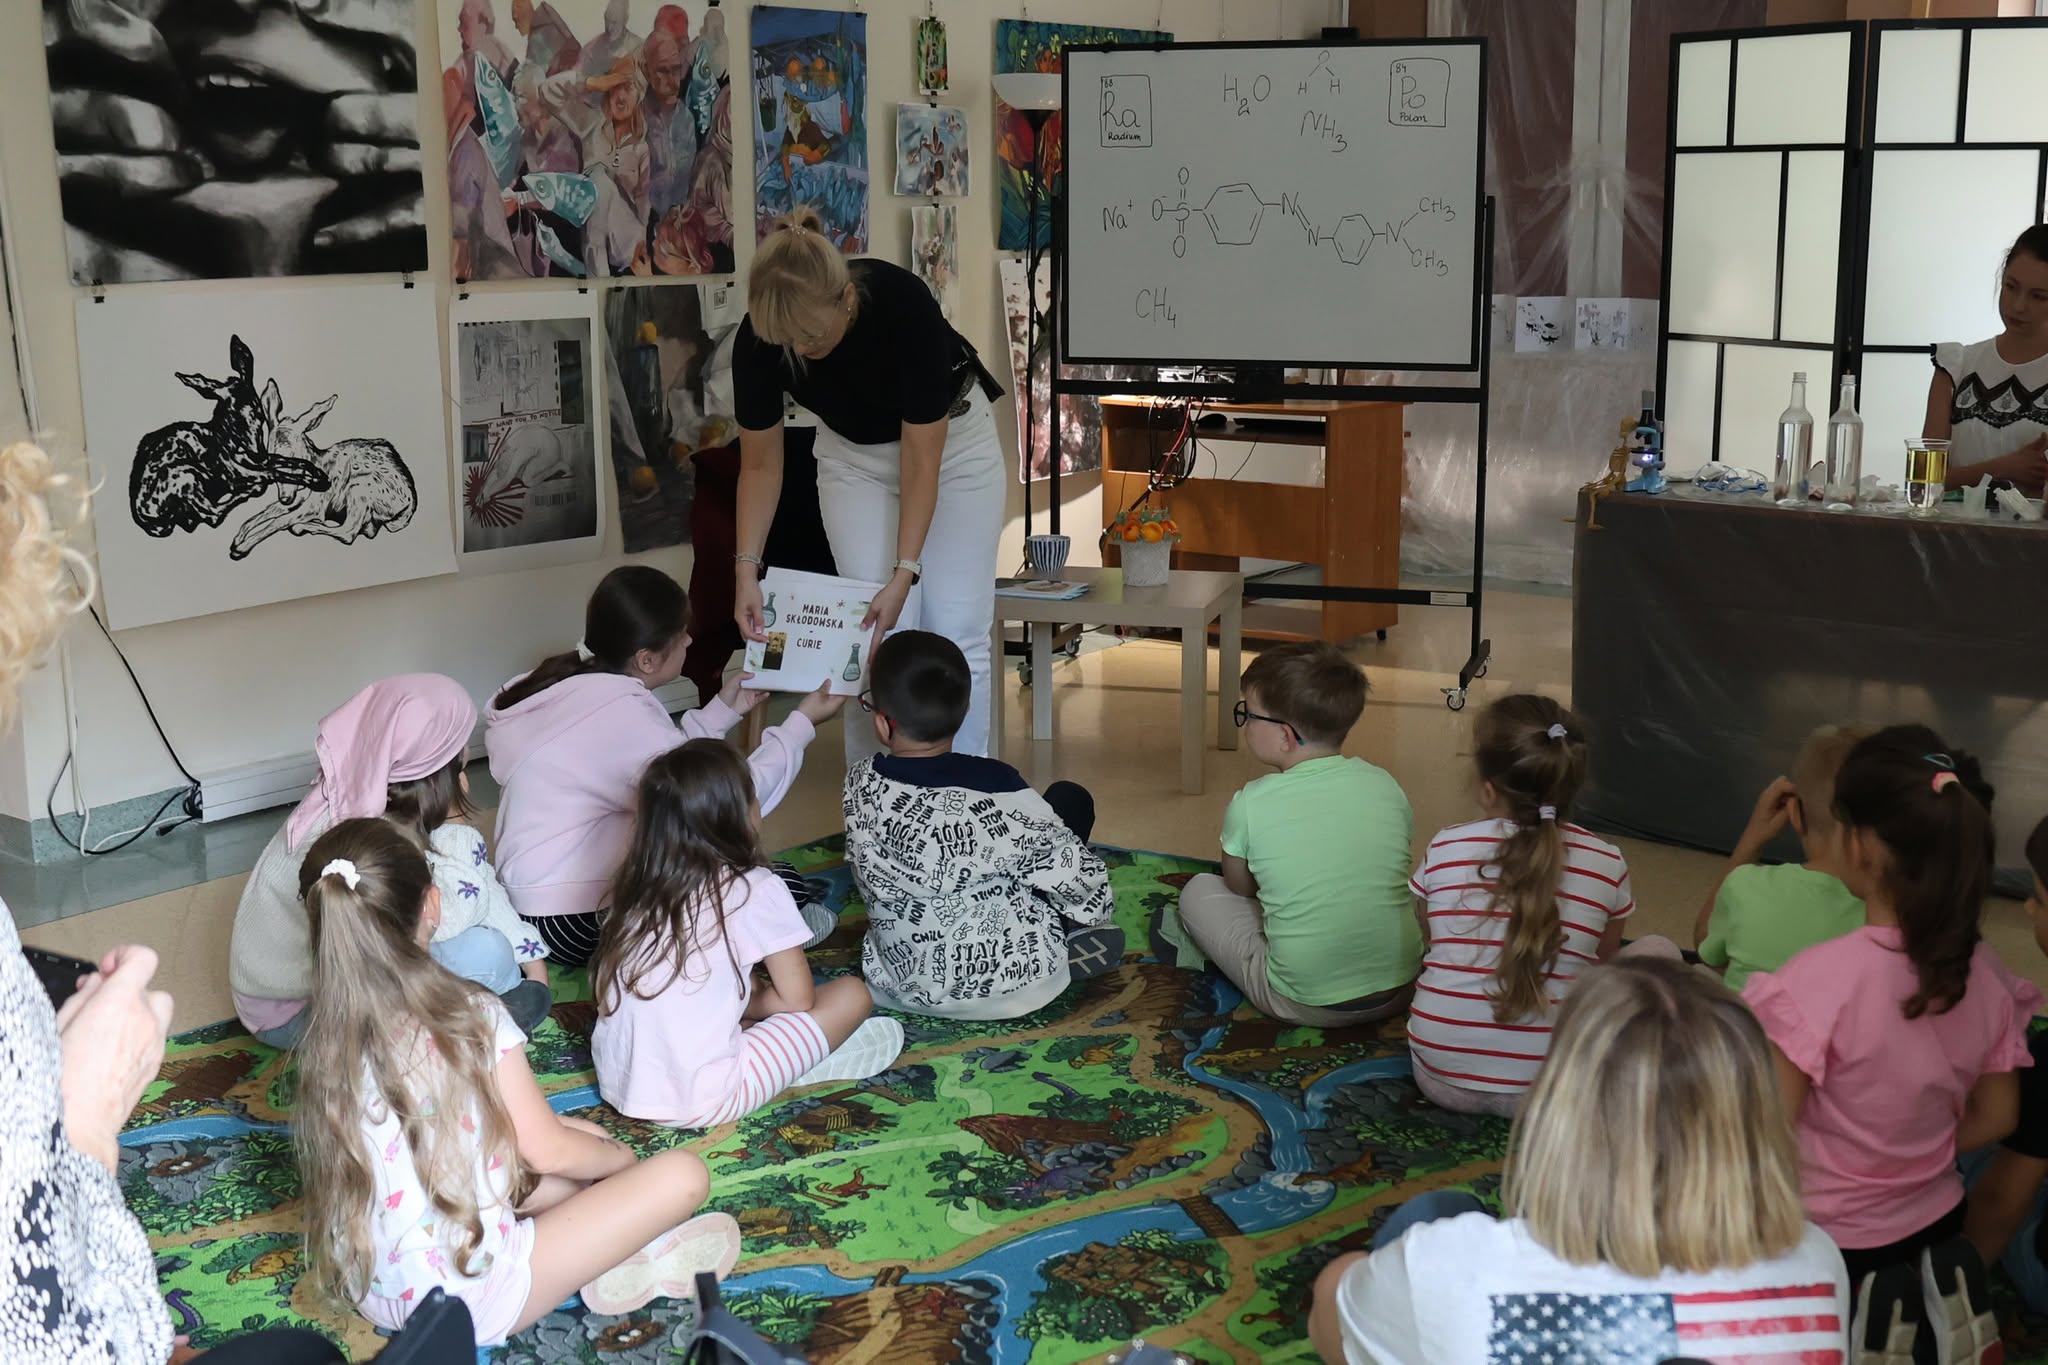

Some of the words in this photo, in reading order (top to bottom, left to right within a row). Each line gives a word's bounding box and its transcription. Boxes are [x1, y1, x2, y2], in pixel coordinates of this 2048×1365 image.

[1396, 62, 1407, 73] 84
[1104, 79, 1113, 88] 88
[1298, 81, 1307, 95] H
[1330, 78, 1340, 94] H
[1401, 75, 1426, 109] Po
[1103, 90, 1140, 131] Ra
[1108, 131, 1141, 141] Radium
[1281, 191, 1299, 215] N
[1419, 197, 1456, 222] CH3
[1308, 226, 1320, 246] N
[1386, 220, 1403, 244] N
[1411, 248, 1448, 276] CH3
[1136, 287, 1176, 328] CH4
[802, 604, 829, 616] MARIA
[785, 613, 844, 629] SKŁODOWSKA
[796, 638, 822, 650] CURIE
[891, 791, 912, 813] NON
[904, 797, 925, 822] STOP
[945, 790, 966, 816] YOR
[968, 798, 996, 816] NON
[916, 805, 935, 825] FUN
[979, 810, 1003, 829] STOP
[987, 821, 1010, 840] FUN
[971, 885, 1003, 902] CHILL
[893, 899, 908, 919] TOP
[908, 900, 926, 926] NON
[931, 896, 955, 927] ORK
[911, 930, 944, 943] CHILL
[951, 938, 998, 961] STAY
